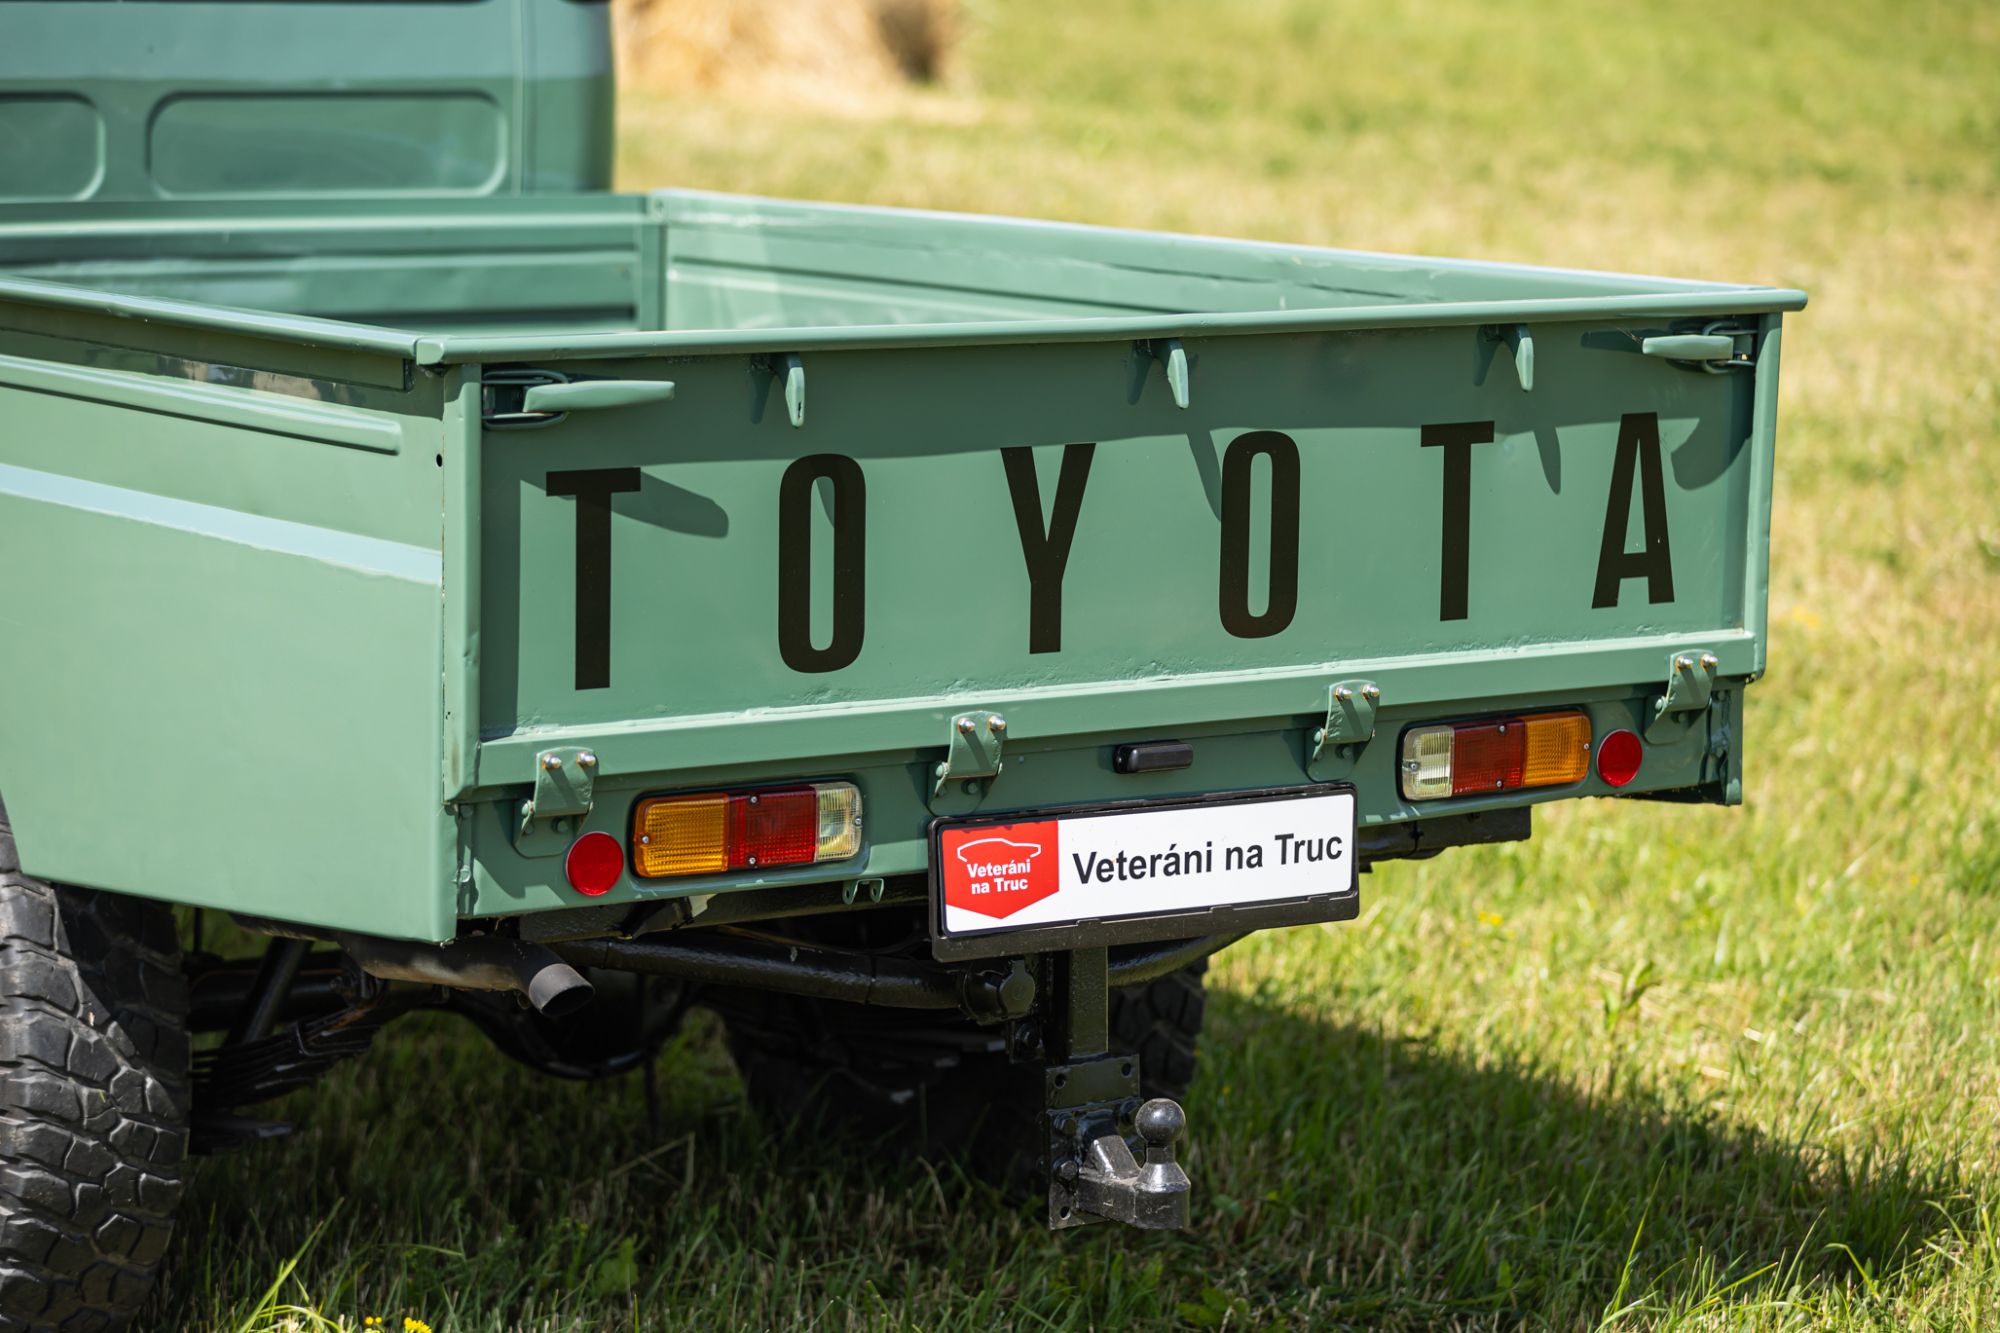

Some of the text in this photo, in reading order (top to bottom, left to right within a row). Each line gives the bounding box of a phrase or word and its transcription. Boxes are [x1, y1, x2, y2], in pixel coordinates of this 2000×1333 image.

[545, 411, 1675, 691] TOYOTA
[966, 858, 1031, 878] Veteráni
[1072, 832, 1343, 885] Veteráni na Truc
[971, 877, 1029, 895] na Truc
